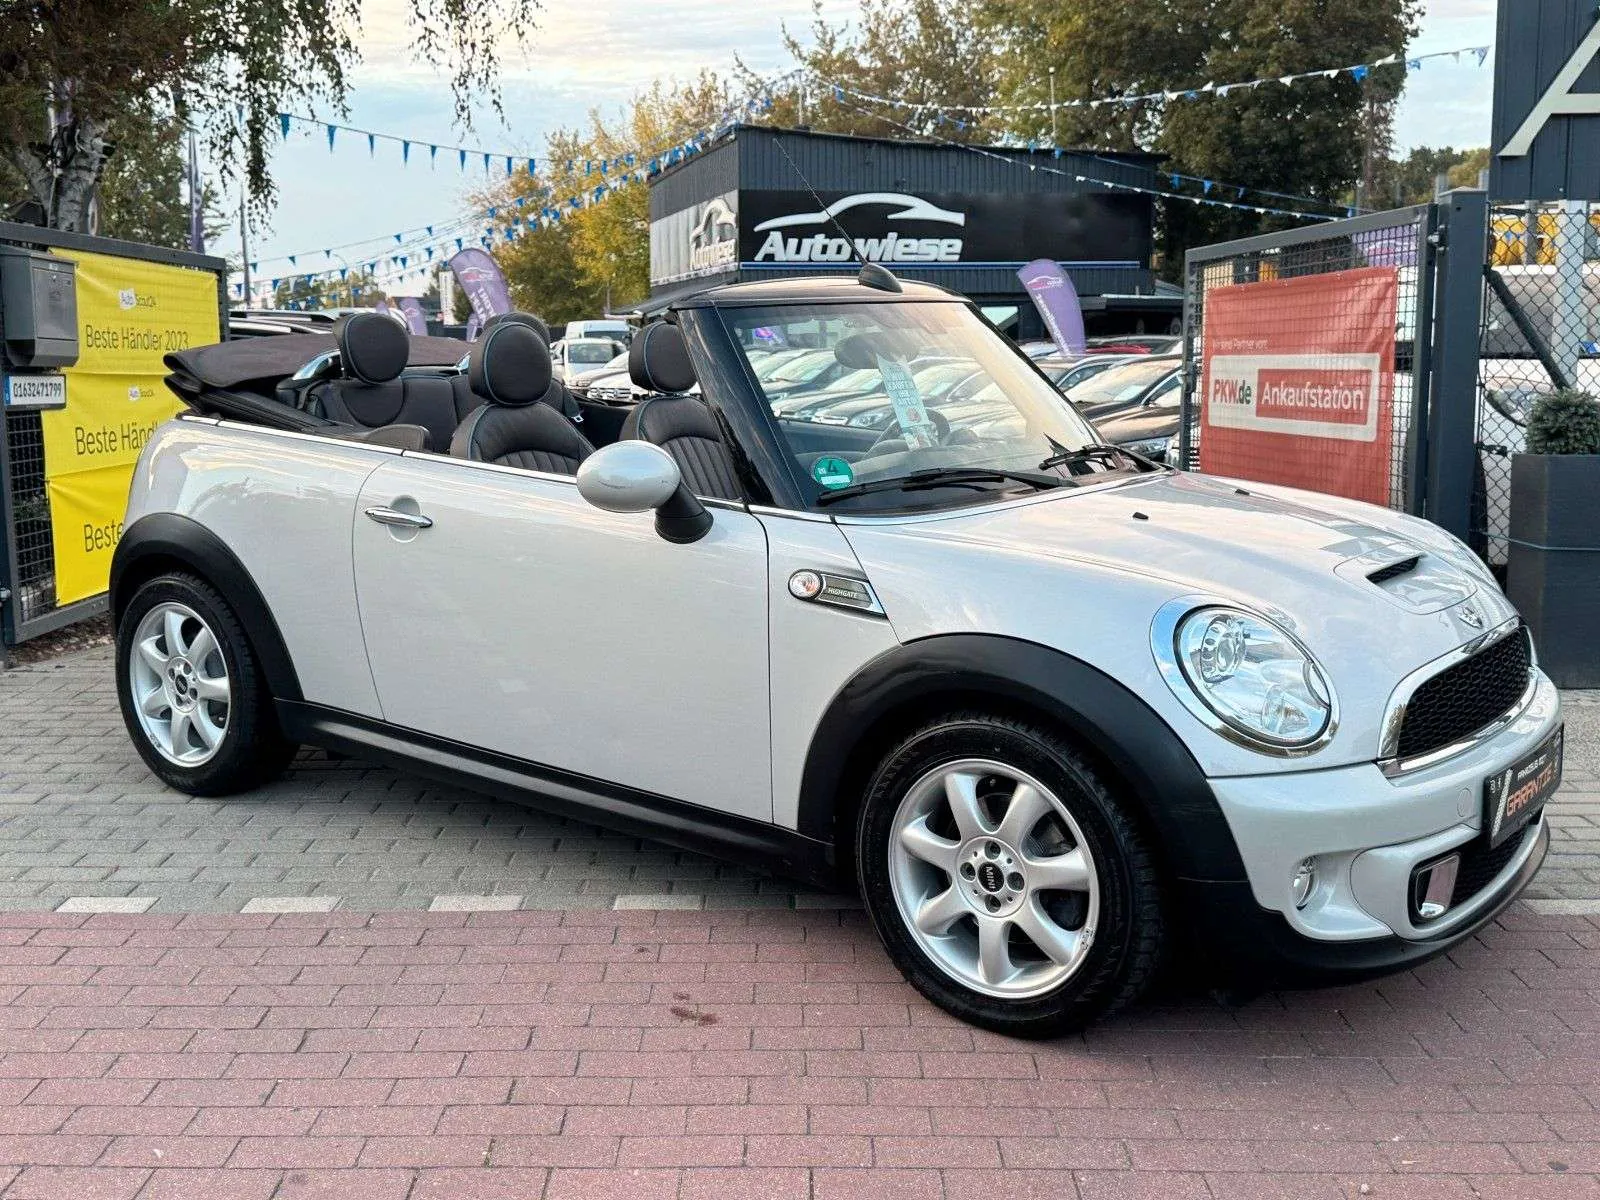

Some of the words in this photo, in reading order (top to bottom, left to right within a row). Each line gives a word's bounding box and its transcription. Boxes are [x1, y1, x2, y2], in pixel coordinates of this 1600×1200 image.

[85, 324, 119, 348] Beste
[120, 327, 162, 351] Händler
[164, 330, 189, 352] 2023
[1211, 379, 1252, 405] PKW.de
[1261, 381, 1365, 411] Ankaufstation
[75, 426, 117, 455] Beste
[985, 866, 997, 889] MINI
